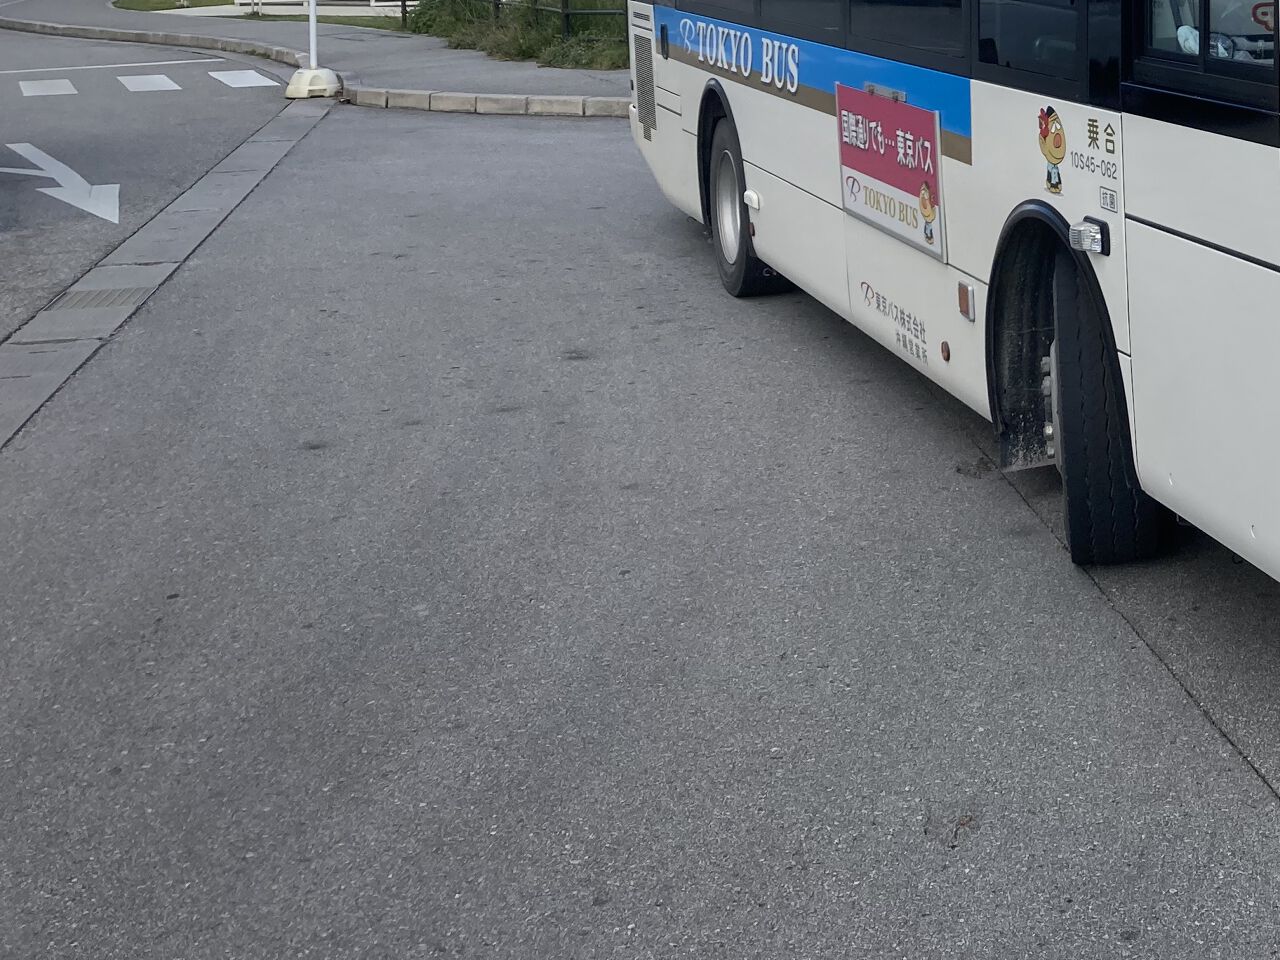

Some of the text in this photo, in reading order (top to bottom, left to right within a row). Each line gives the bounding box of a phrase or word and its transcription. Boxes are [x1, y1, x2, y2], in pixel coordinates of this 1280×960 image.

[696, 21, 799, 93] TOKYO BUS
[1087, 118, 1116, 155] 乗合
[1070, 151, 1118, 180] 10S45-062
[863, 185, 919, 230] TOKYO BUS
[875, 291, 927, 345] 東京バス株式会社
